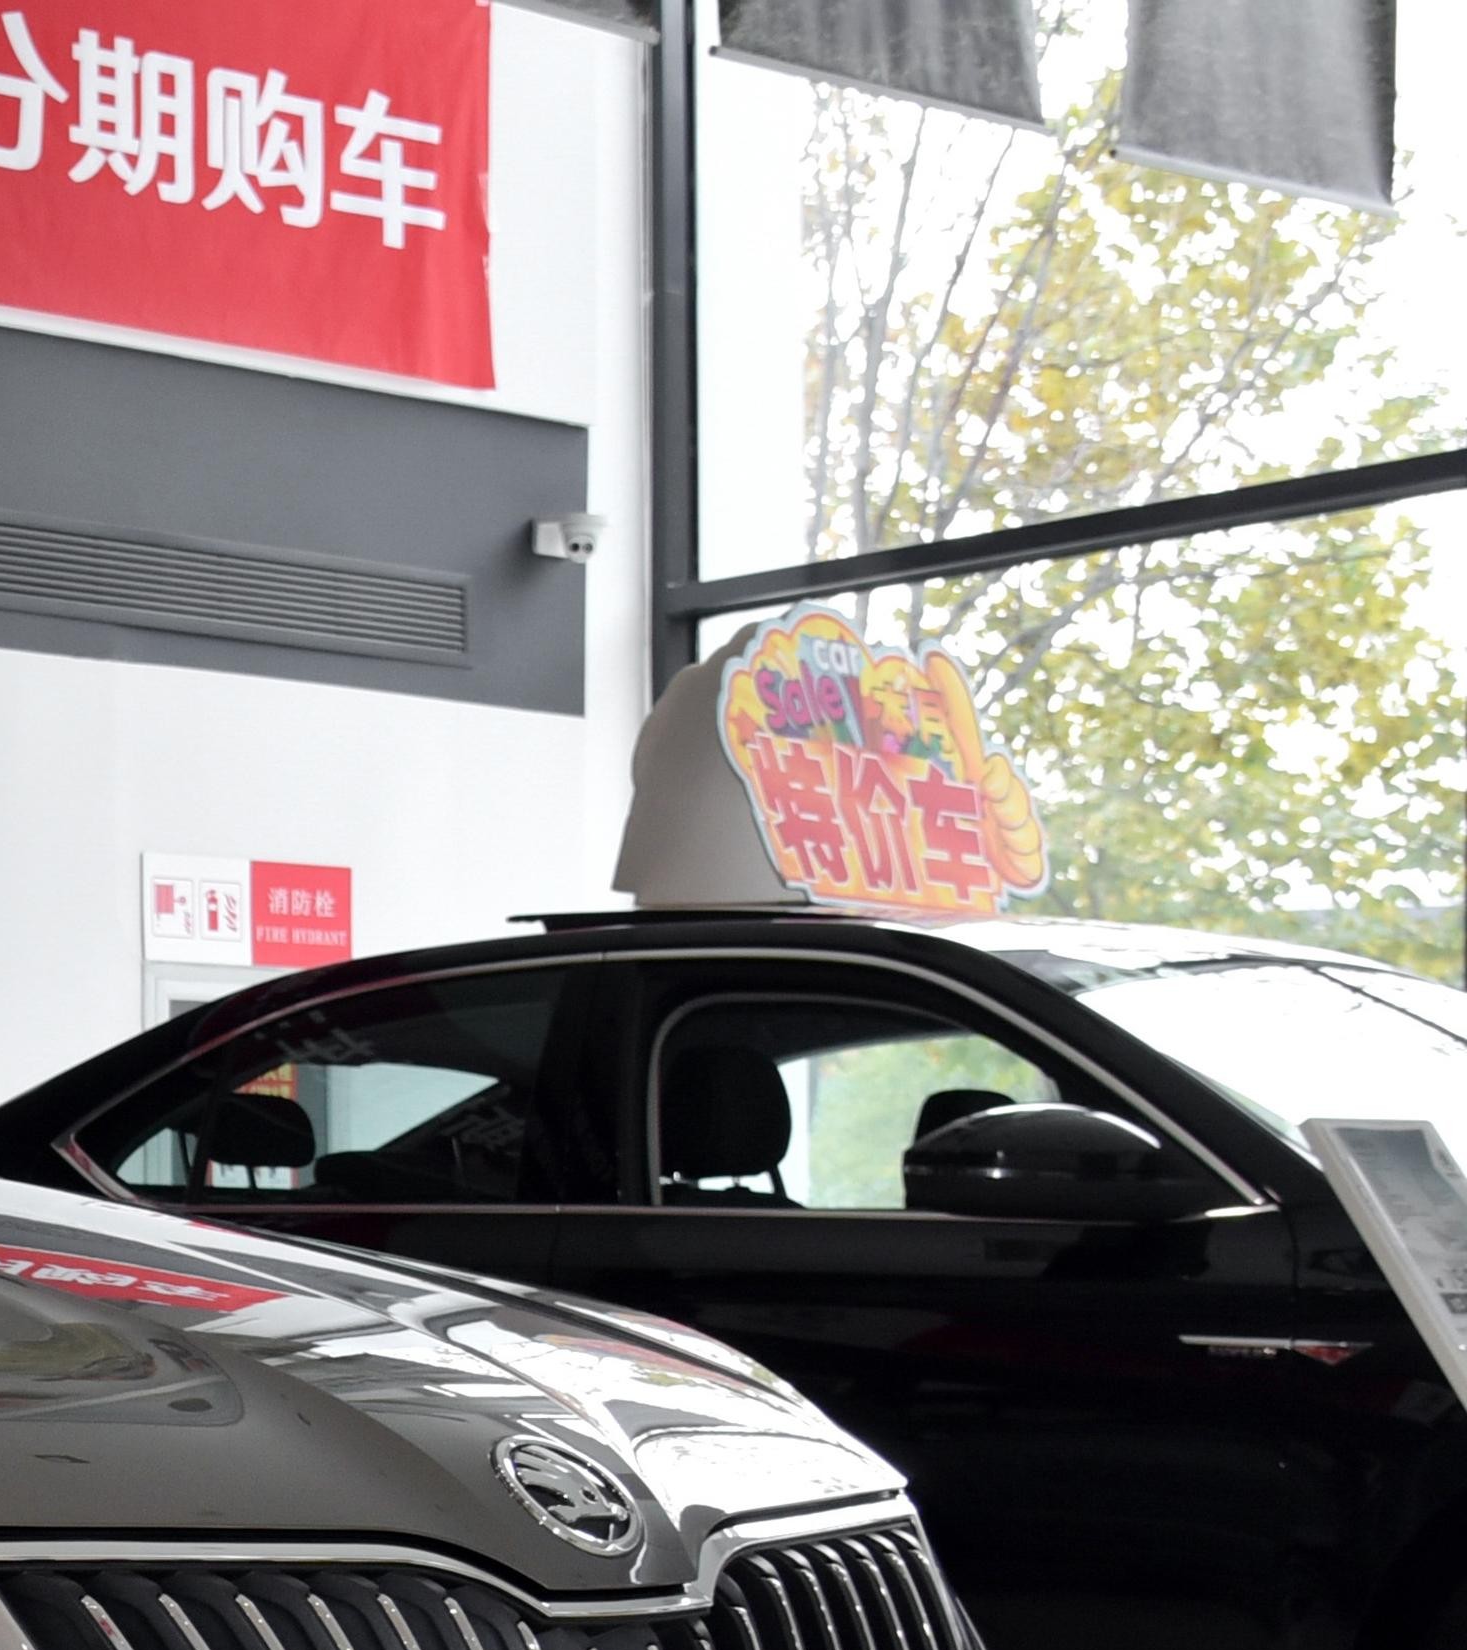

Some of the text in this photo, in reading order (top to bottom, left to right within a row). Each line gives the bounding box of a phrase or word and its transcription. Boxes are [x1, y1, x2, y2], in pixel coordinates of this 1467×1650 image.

[754, 660, 846, 730] Sale
[746, 732, 994, 902] 特价车
[269, 887, 337, 918] 消防栓
[255, 925, 348, 946] FIRE HYDRANT
